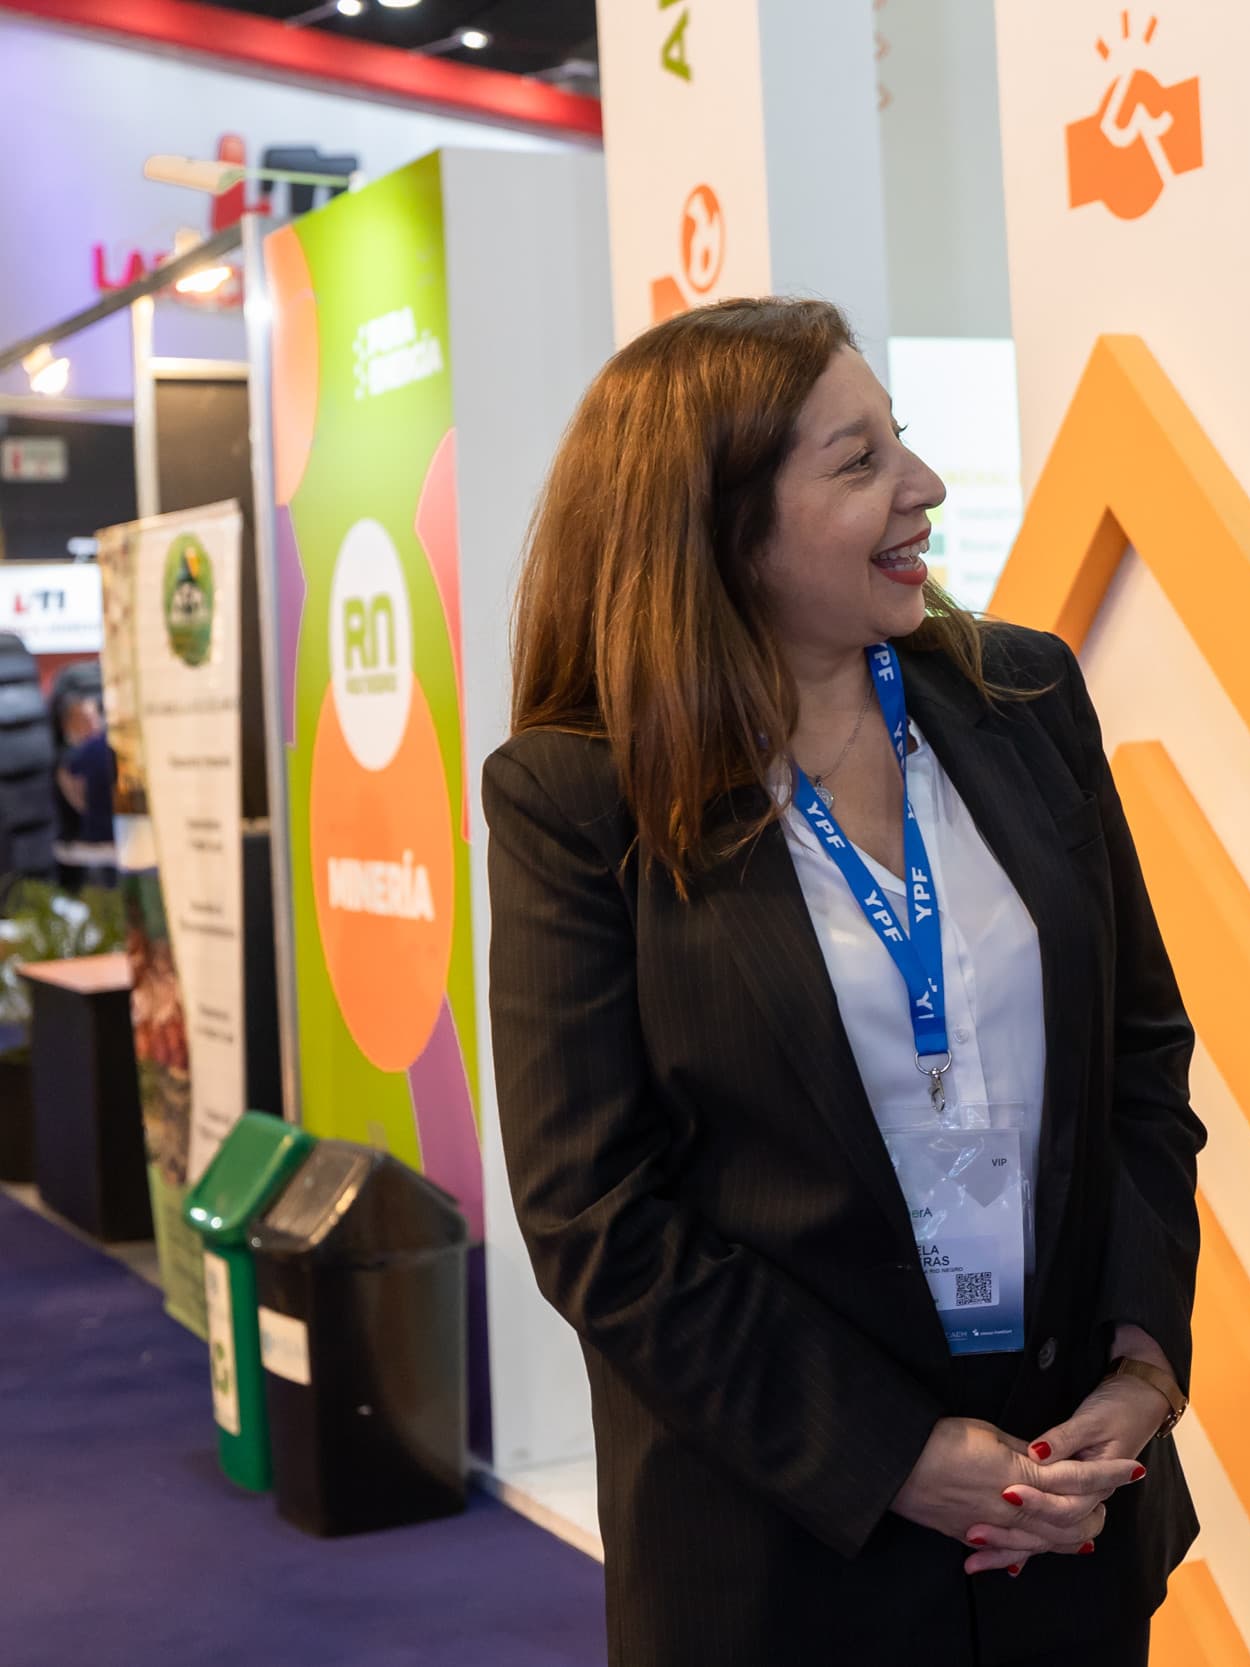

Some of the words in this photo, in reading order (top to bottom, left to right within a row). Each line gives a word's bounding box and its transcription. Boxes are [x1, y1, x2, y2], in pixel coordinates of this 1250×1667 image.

[874, 642, 895, 682] PF
[806, 801, 846, 849] YPF
[864, 889, 904, 942] YPF
[912, 867, 932, 923] YPF
[991, 1158, 1007, 1167] VIP
[921, 1255, 950, 1267] RAS
